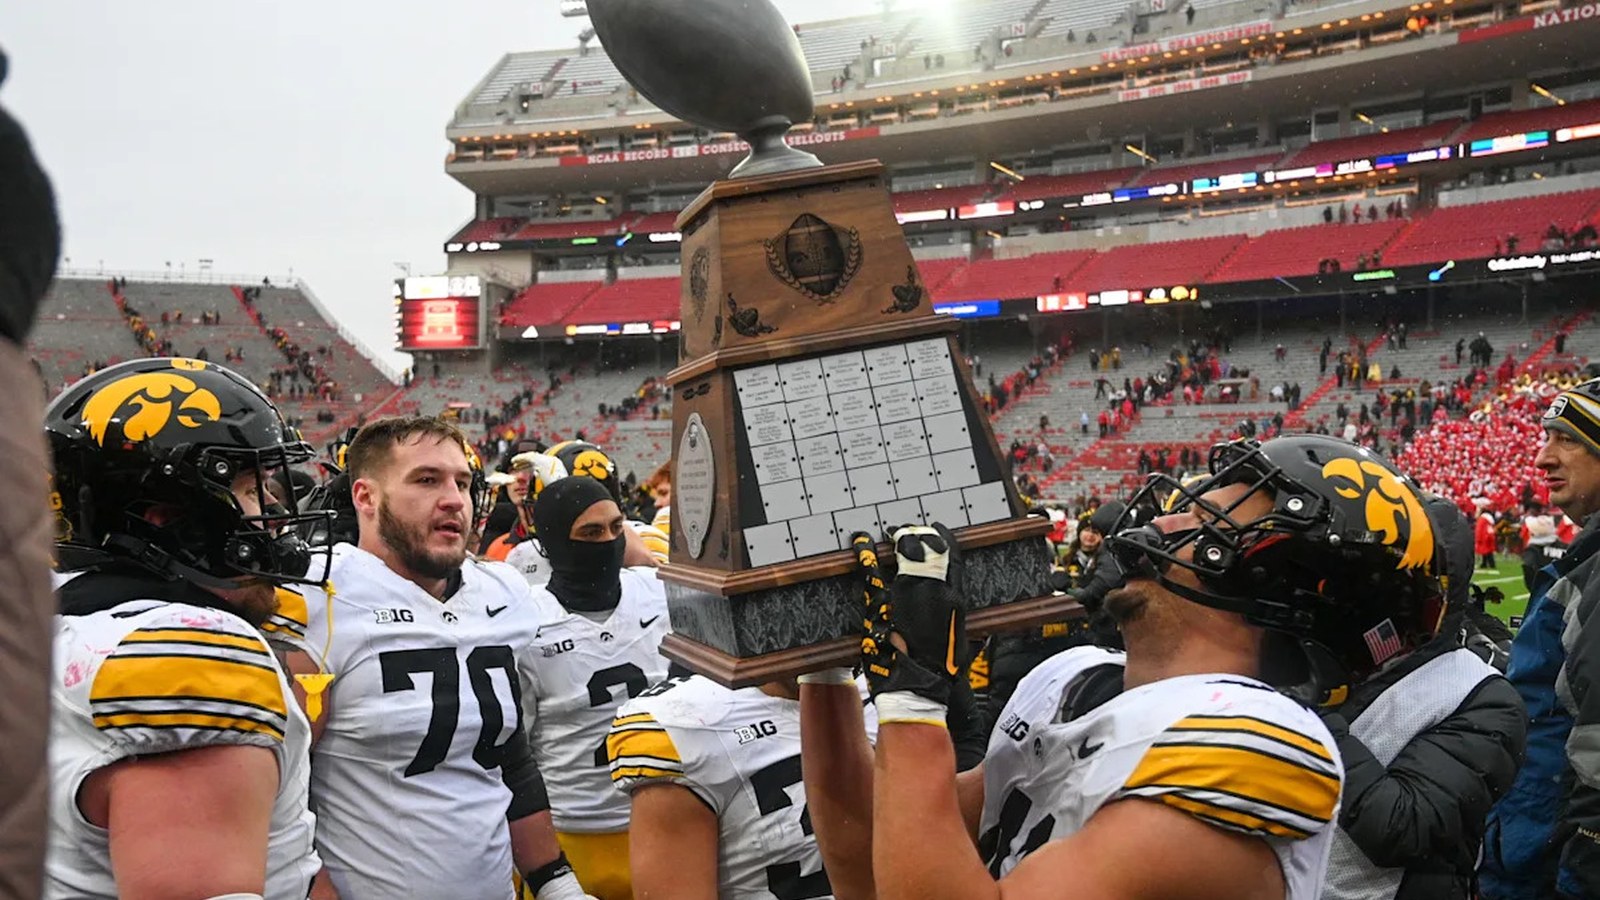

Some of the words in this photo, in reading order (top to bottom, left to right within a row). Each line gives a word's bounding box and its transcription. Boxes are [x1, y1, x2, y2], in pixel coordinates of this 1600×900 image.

[587, 151, 619, 164] NCAA
[623, 149, 668, 163] RECORD
[788, 131, 846, 146] SELLOUTS
[379, 645, 523, 778] 70
